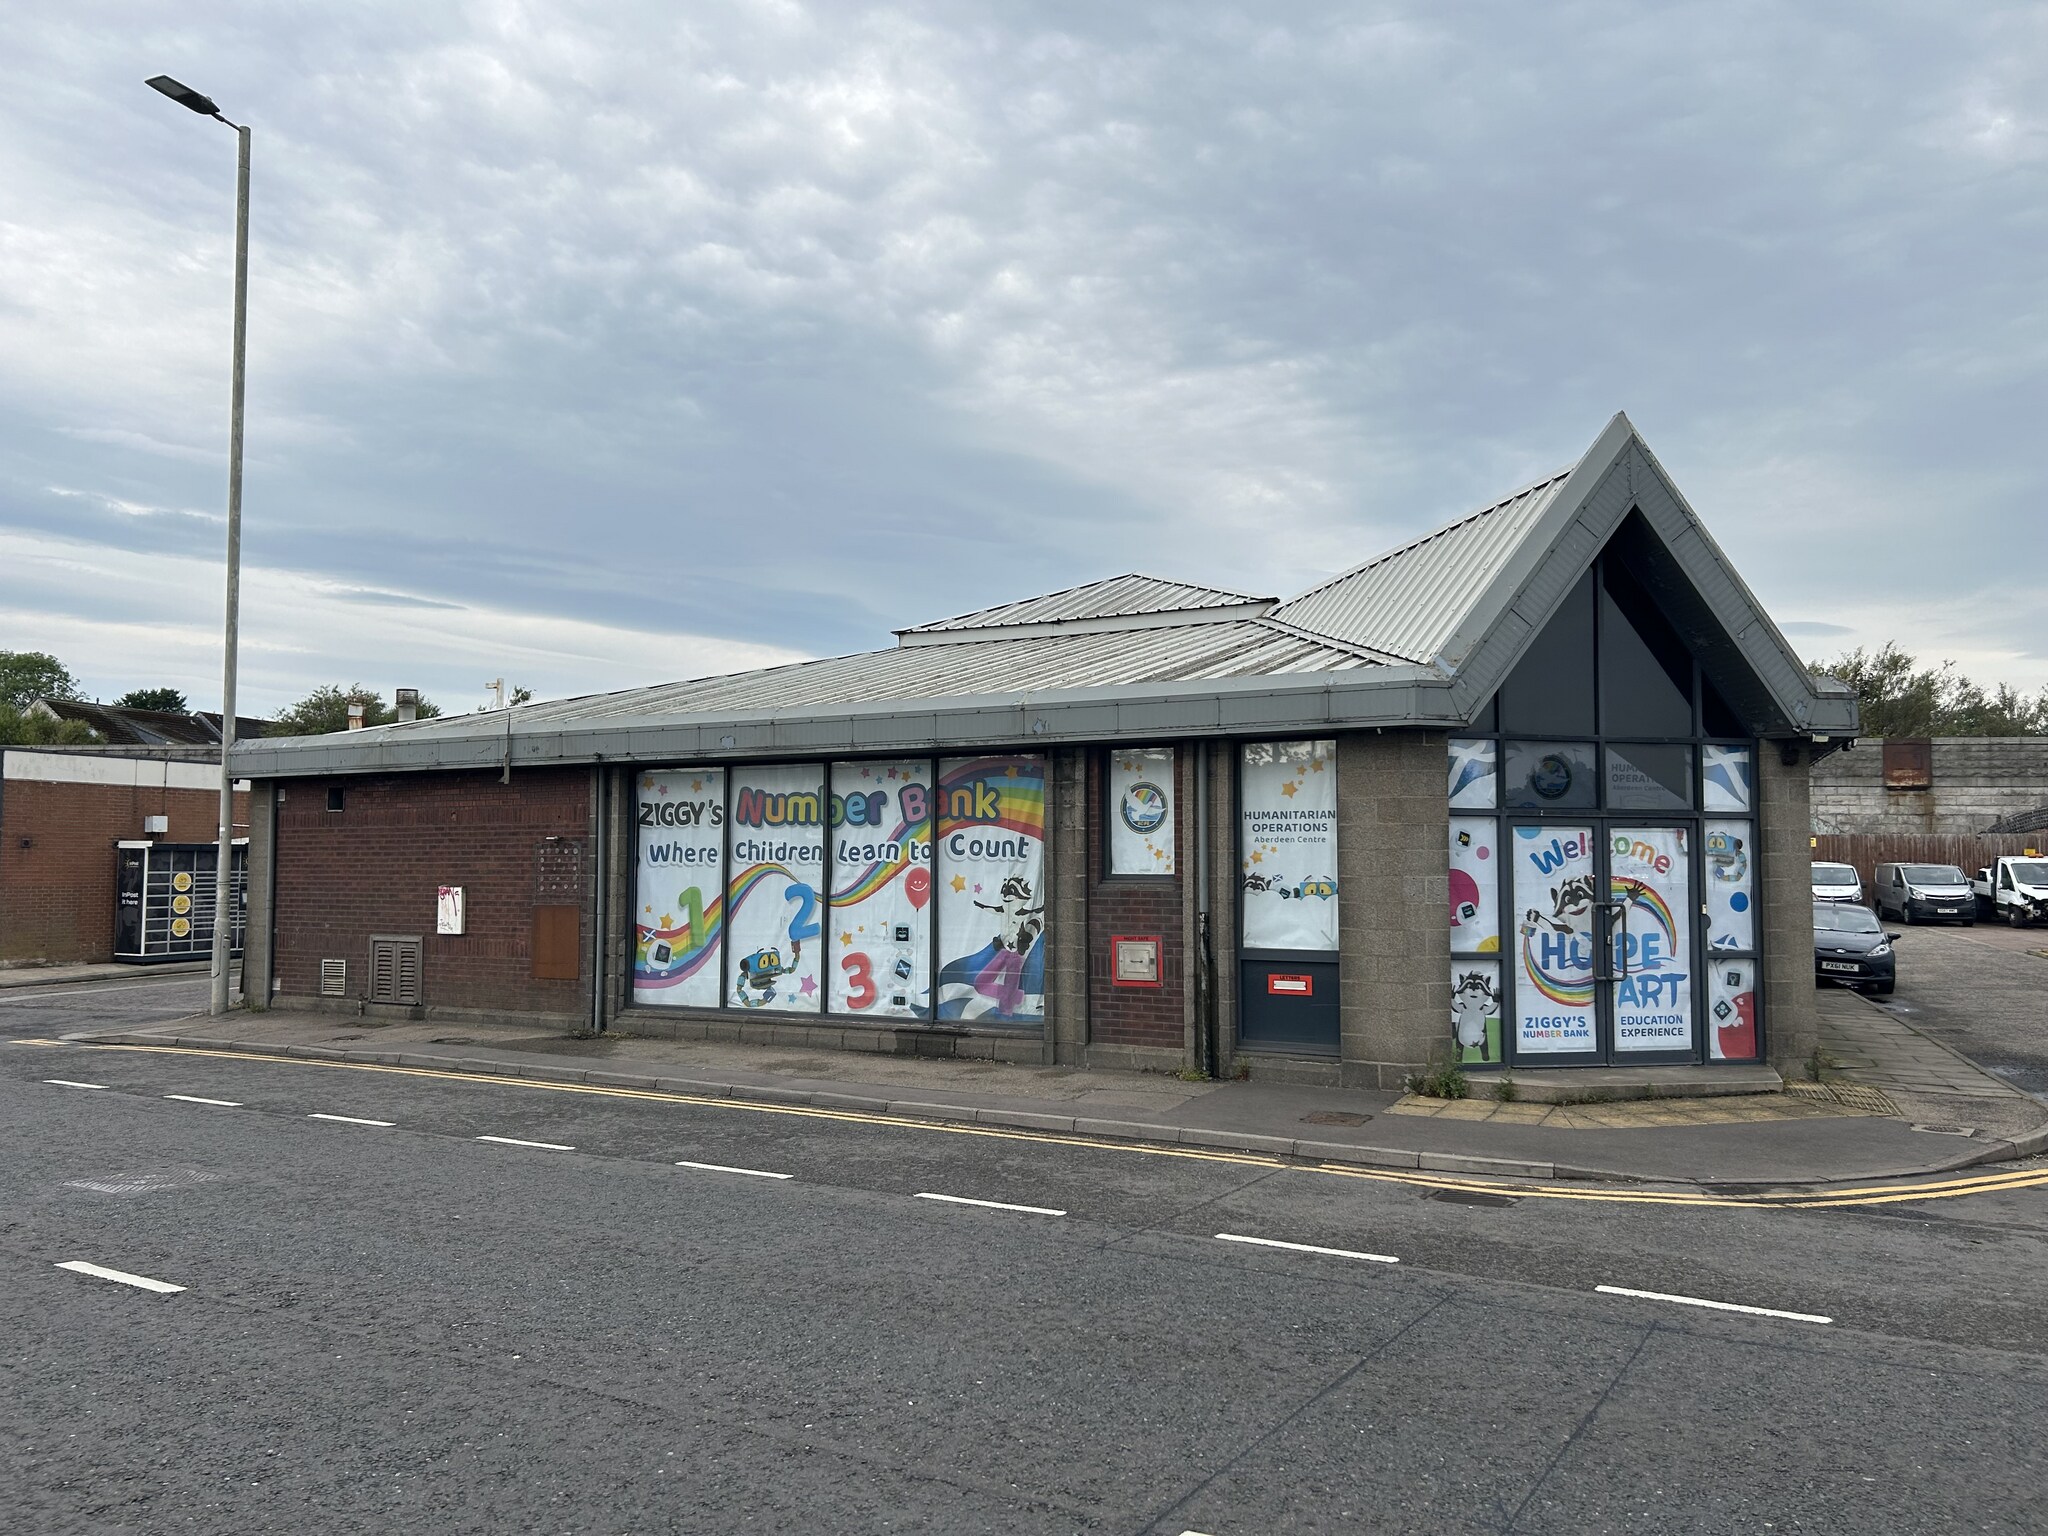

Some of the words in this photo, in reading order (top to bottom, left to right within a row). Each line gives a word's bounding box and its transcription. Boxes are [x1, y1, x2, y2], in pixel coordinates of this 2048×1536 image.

[640, 798, 723, 827] ZIGGY's
[1244, 809, 1336, 820] HUMANITARIAN
[1252, 823, 1328, 833] OPERATIONS
[1254, 836, 1295, 844] Aberdeen
[1297, 836, 1327, 844] Centre
[650, 841, 719, 863] Where
[736, 840, 823, 862] Children
[839, 840, 900, 861] Learn
[909, 840, 932, 860] to
[950, 833, 1030, 860] Count
[1530, 832, 1674, 876] Welome
[679, 887, 706, 947] 1
[785, 883, 820, 941] 2
[1541, 932, 1661, 970] HOPE
[842, 953, 875, 1009] 3
[974, 951, 1024, 1015] 4
[1618, 973, 1687, 1008] ART
[1523, 1030, 1562, 1039] NUMBER
[1563, 1029, 1589, 1038] BANK
[1525, 1016, 1587, 1029] ZIGGY'S
[1620, 1014, 1683, 1025] EDUCATION
[1620, 1027, 1684, 1038] EXPERIENCE
